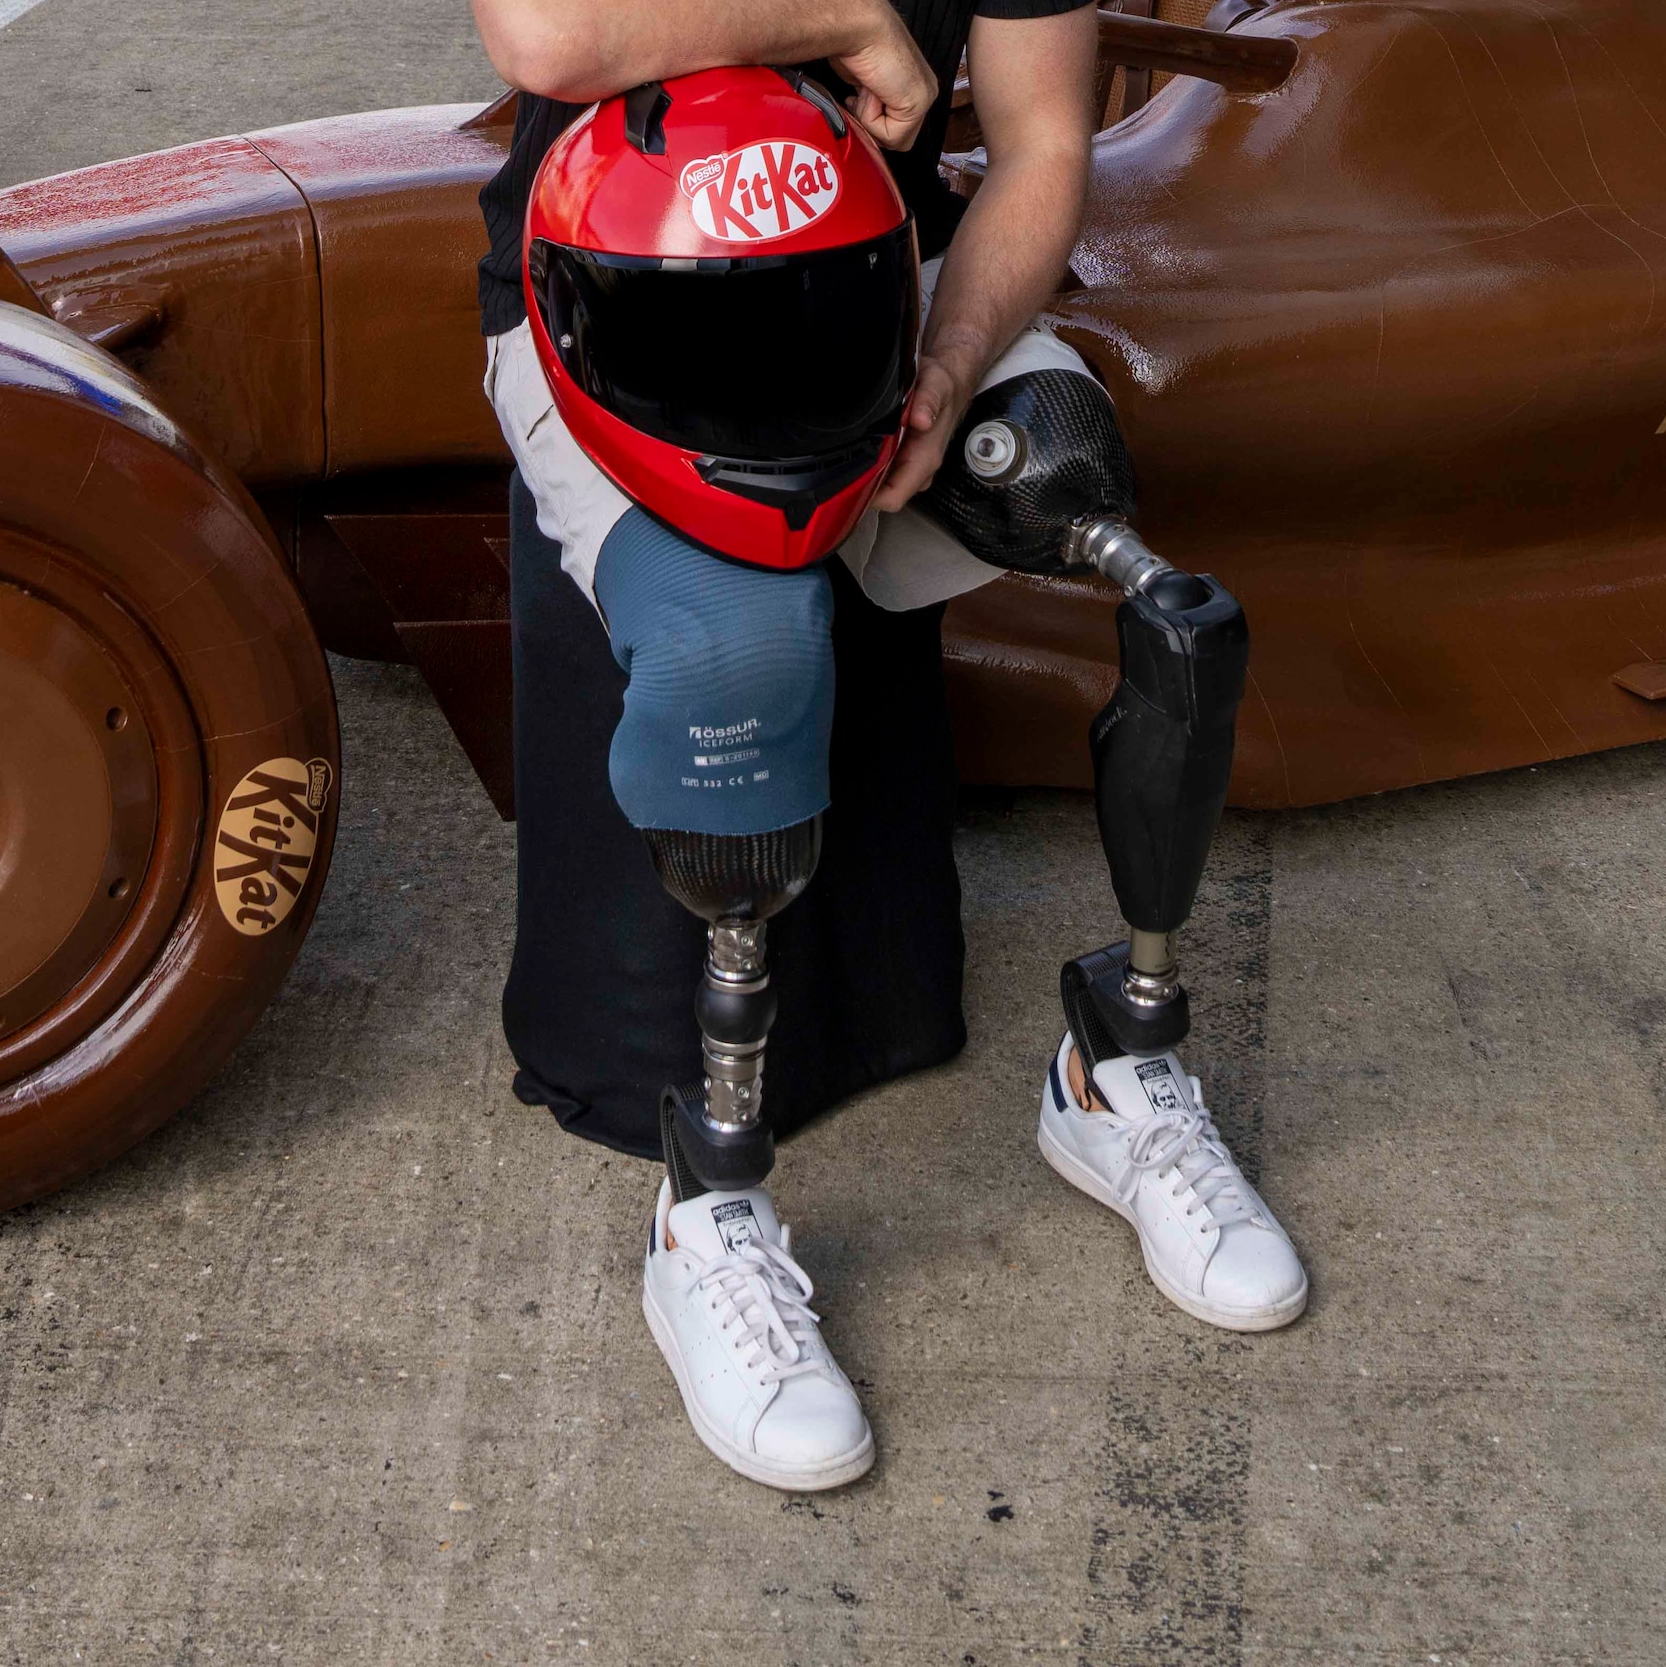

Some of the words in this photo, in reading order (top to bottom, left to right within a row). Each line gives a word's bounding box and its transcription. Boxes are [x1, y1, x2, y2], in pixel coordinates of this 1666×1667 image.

[686, 161, 722, 187] Nestlé
[705, 143, 834, 238] KitKat
[698, 732, 753, 748] ICEFORM
[703, 718, 758, 739] ÖSSUR
[311, 764, 327, 807] Nestlé
[215, 770, 318, 930] KitKat
[1136, 1063, 1160, 1074] adidas
[713, 1203, 741, 1216] adidas
